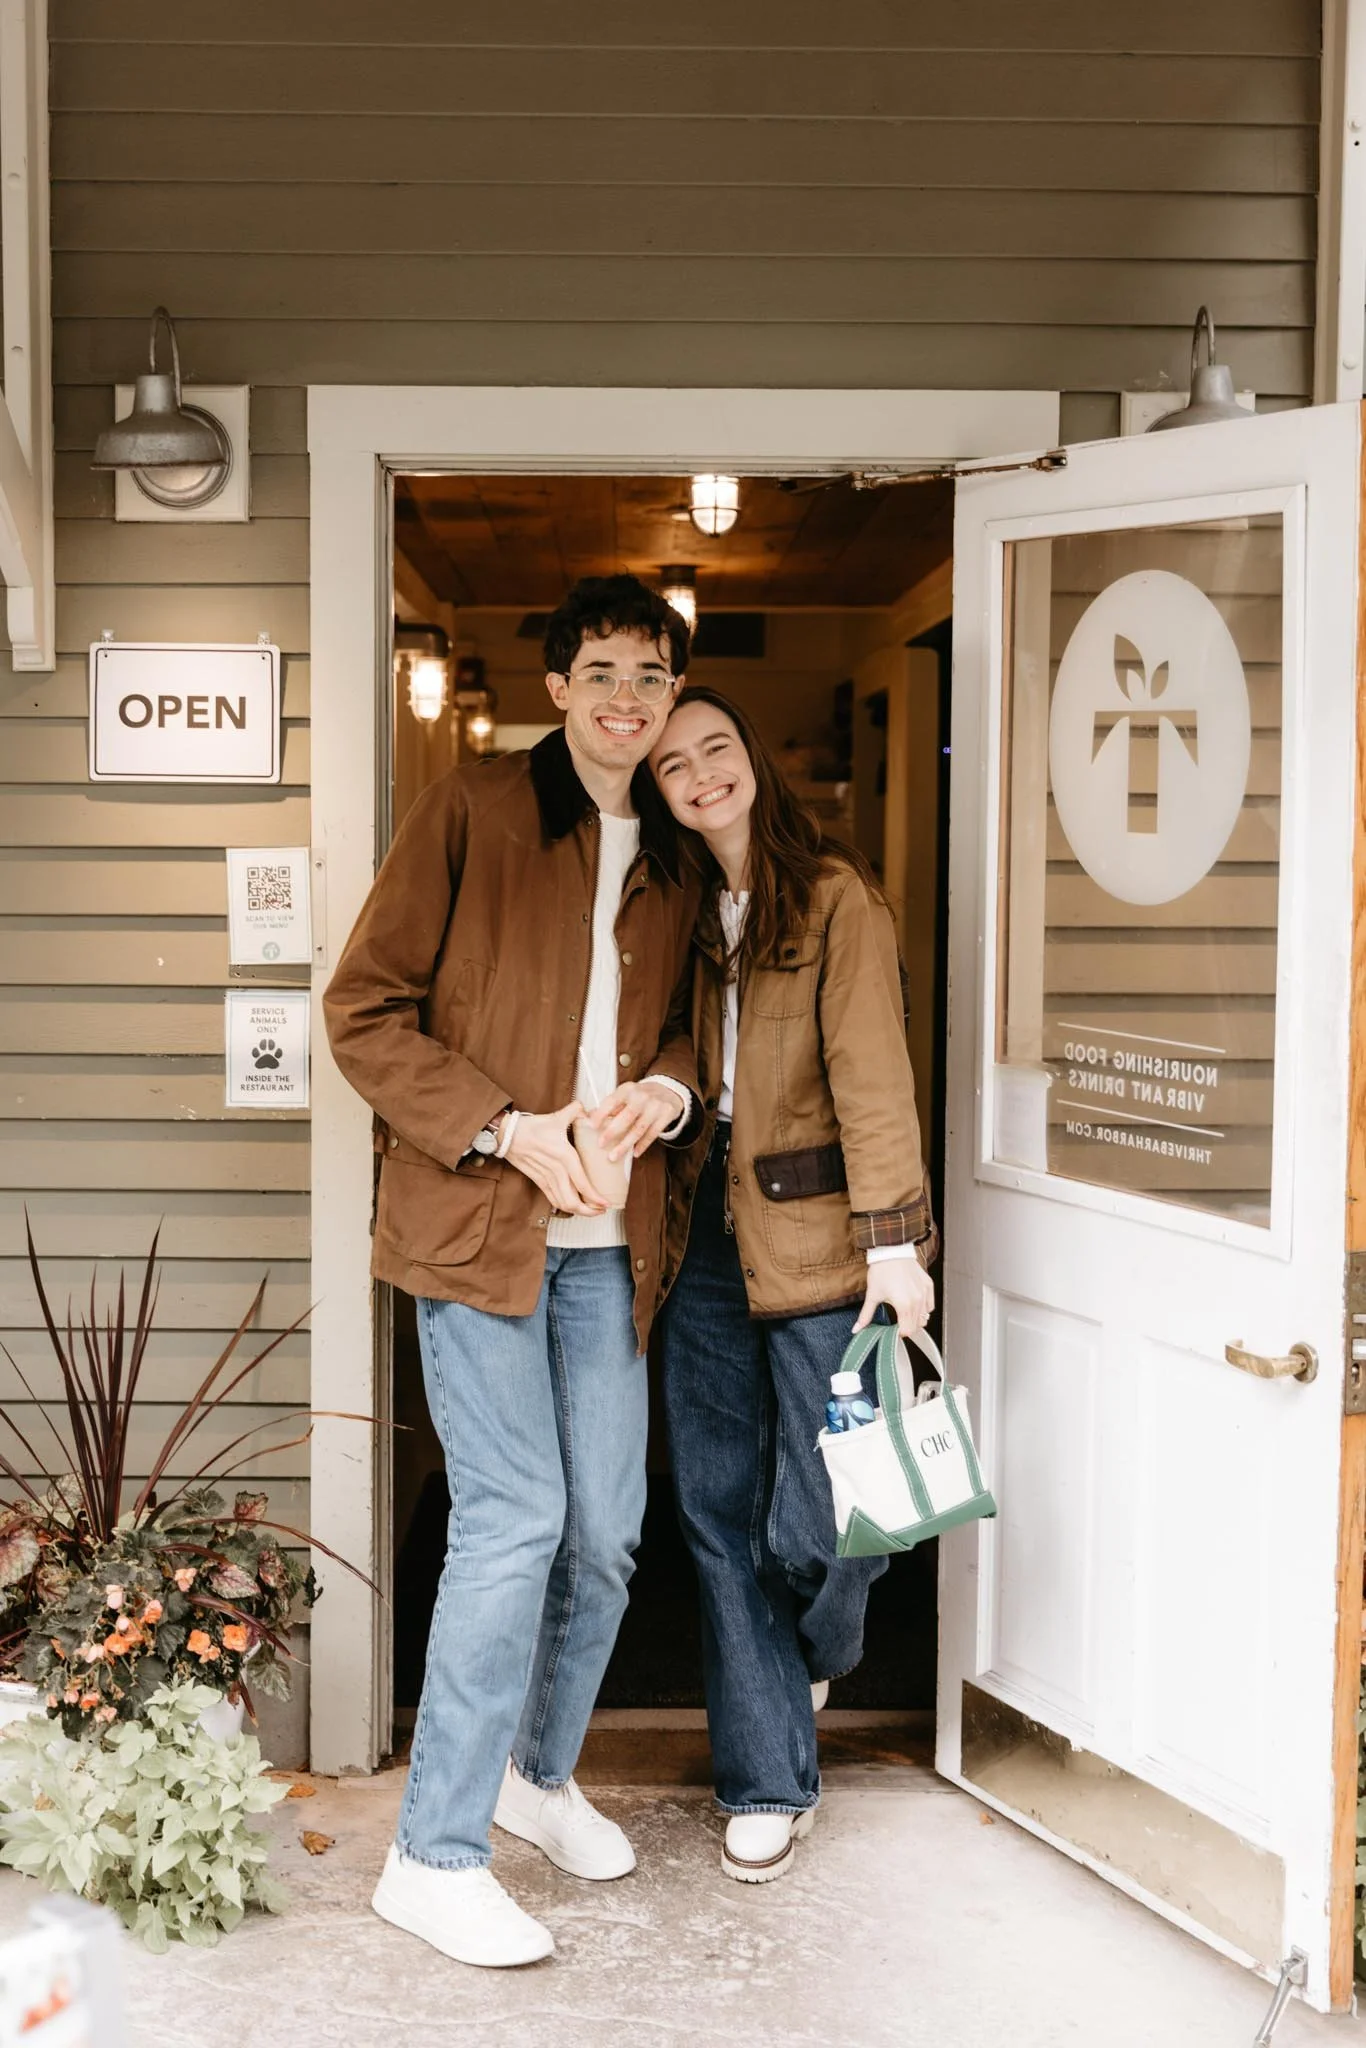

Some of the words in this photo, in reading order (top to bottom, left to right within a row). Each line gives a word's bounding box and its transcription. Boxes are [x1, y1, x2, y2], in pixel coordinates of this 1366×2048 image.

[118, 693, 246, 730] OPEN
[251, 1007, 285, 1015] SERVICE
[250, 1016, 287, 1025] ANIMALS
[257, 1025, 278, 1033] ONLY
[240, 1083, 294, 1092] RESTAURANT
[920, 1430, 955, 1458] CHC
